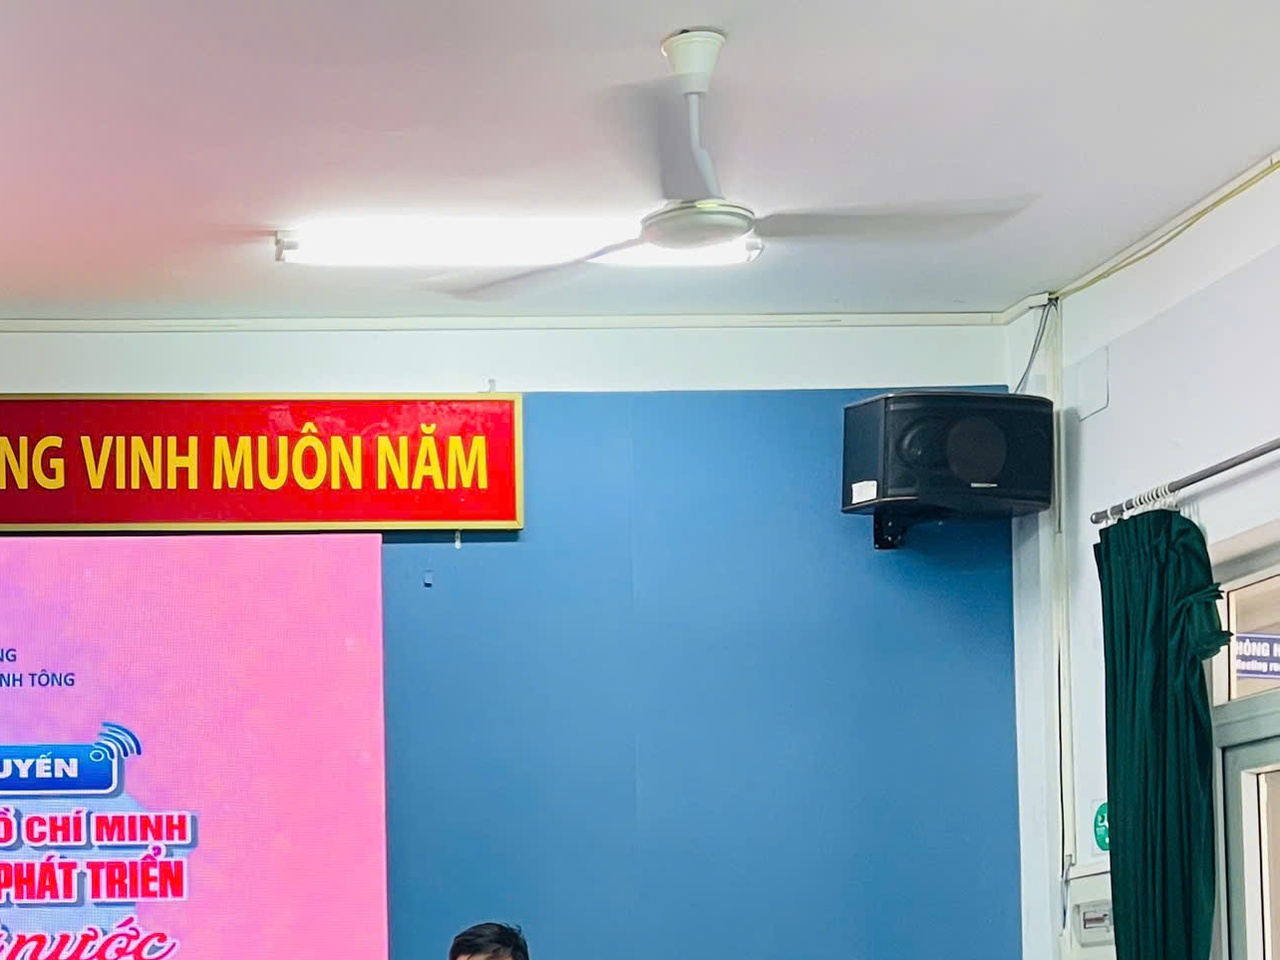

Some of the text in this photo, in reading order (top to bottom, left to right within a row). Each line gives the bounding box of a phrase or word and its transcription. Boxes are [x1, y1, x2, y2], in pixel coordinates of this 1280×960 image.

[80, 435, 199, 490] VINH
[212, 422, 362, 490] MUÔN
[377, 423, 488, 490] NĂM
[28, 669, 75, 687] TÔNG
[25, 809, 84, 843] CHÍ
[95, 814, 187, 842] MINH
[86, 845, 184, 899] TRIỂN
